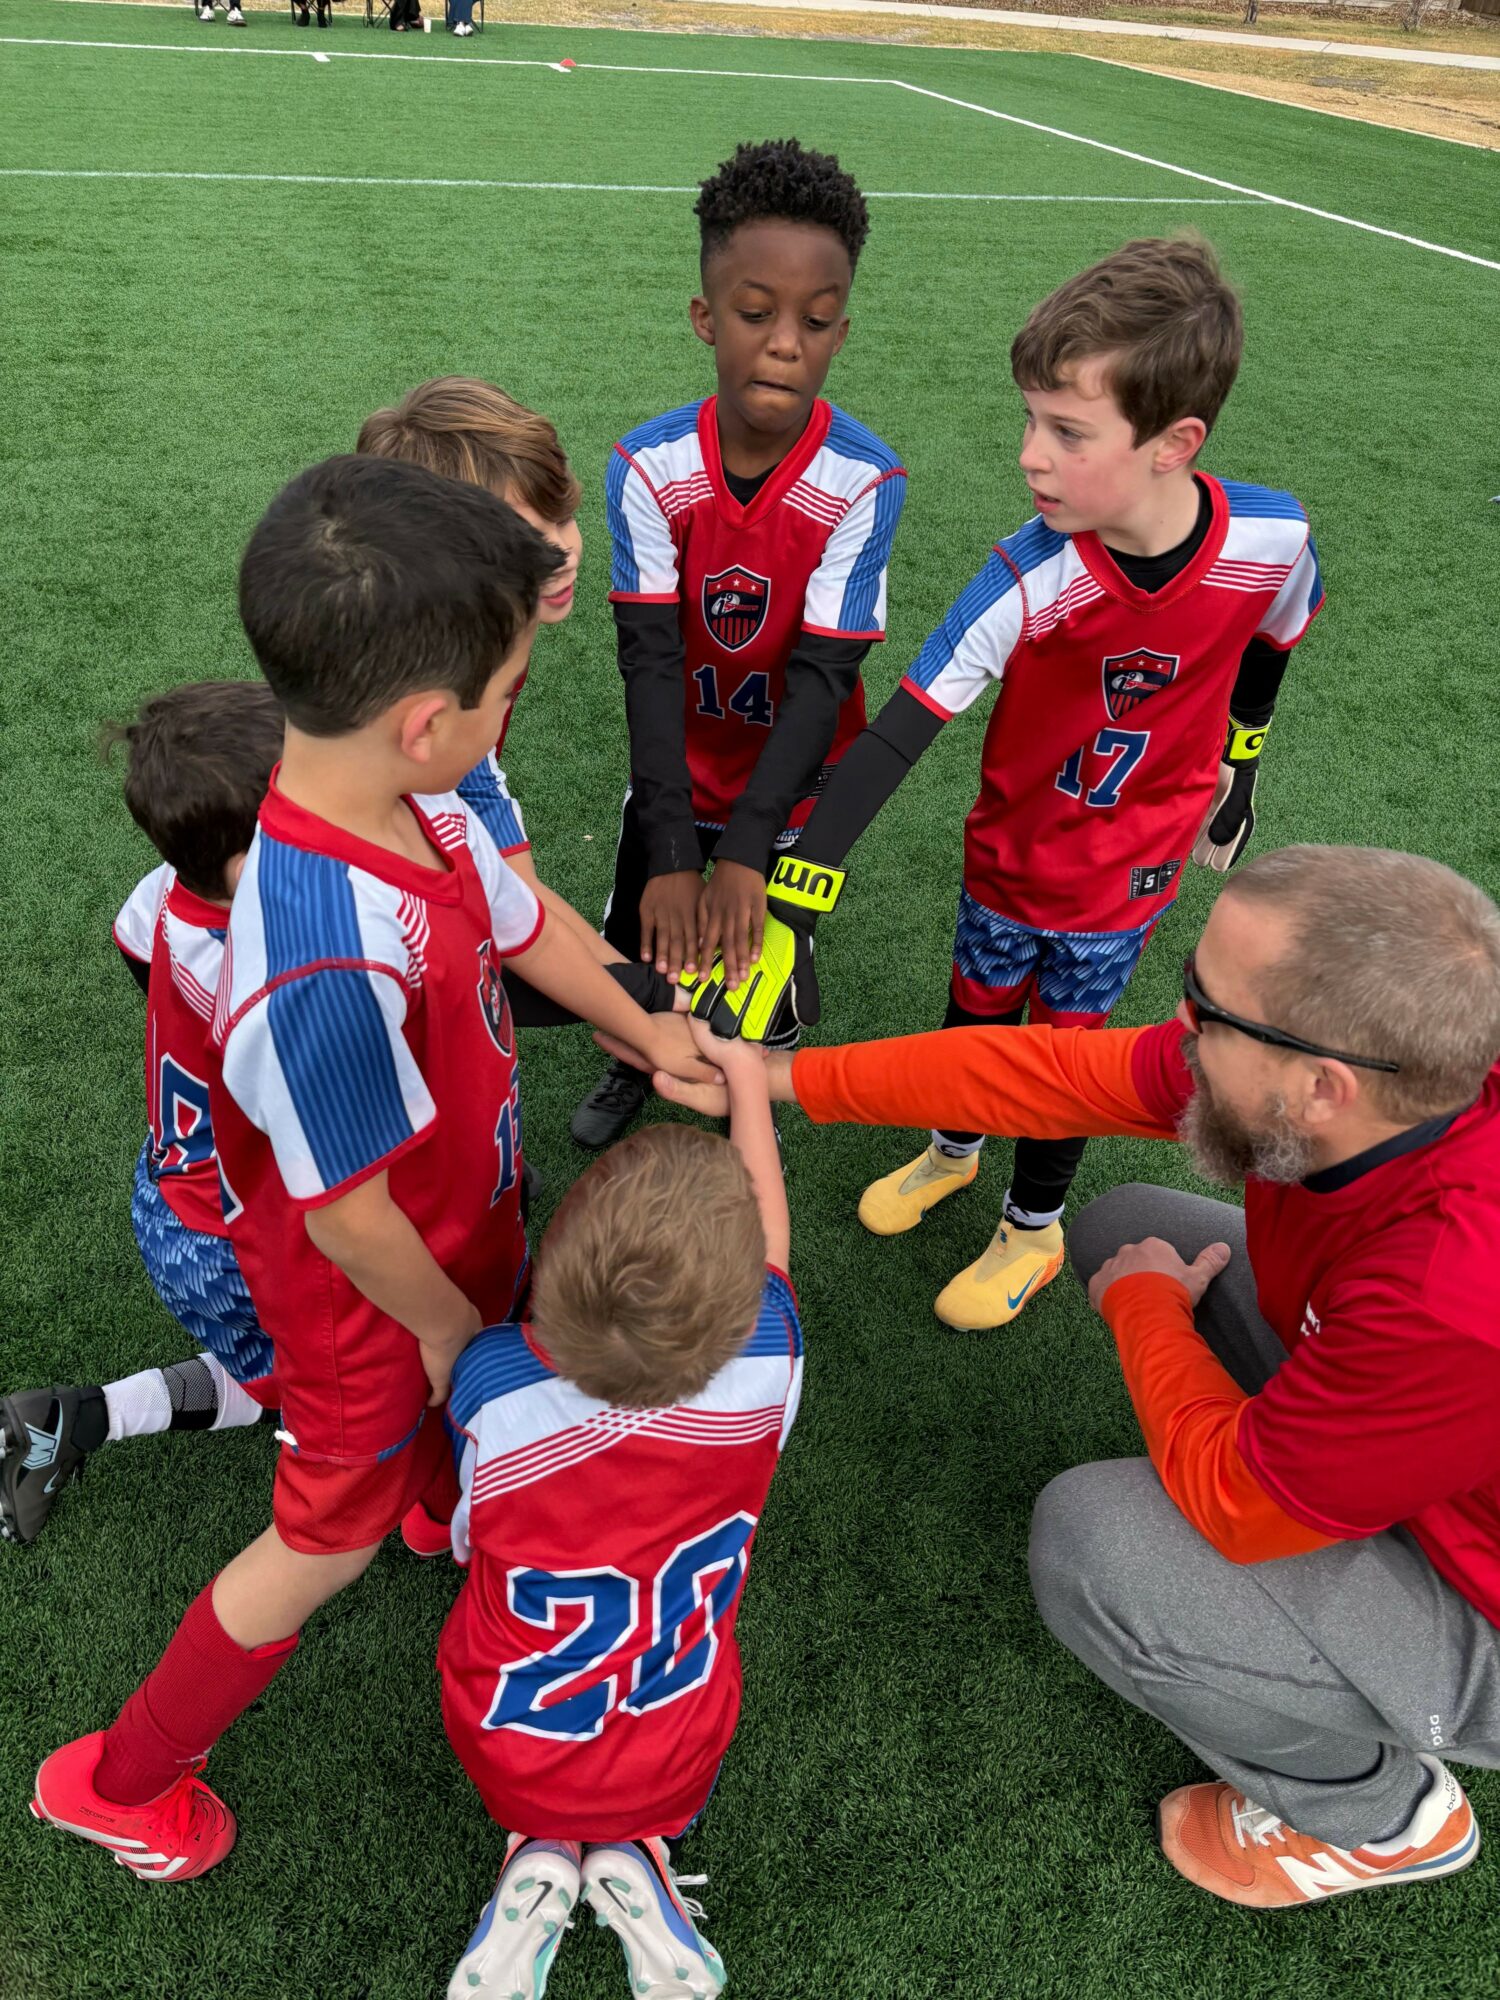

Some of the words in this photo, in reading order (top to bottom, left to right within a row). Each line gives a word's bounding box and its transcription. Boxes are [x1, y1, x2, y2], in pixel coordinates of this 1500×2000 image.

[693, 664, 774, 727] 14
[1054, 727, 1151, 807] 17
[481, 1510, 758, 1741] 20
